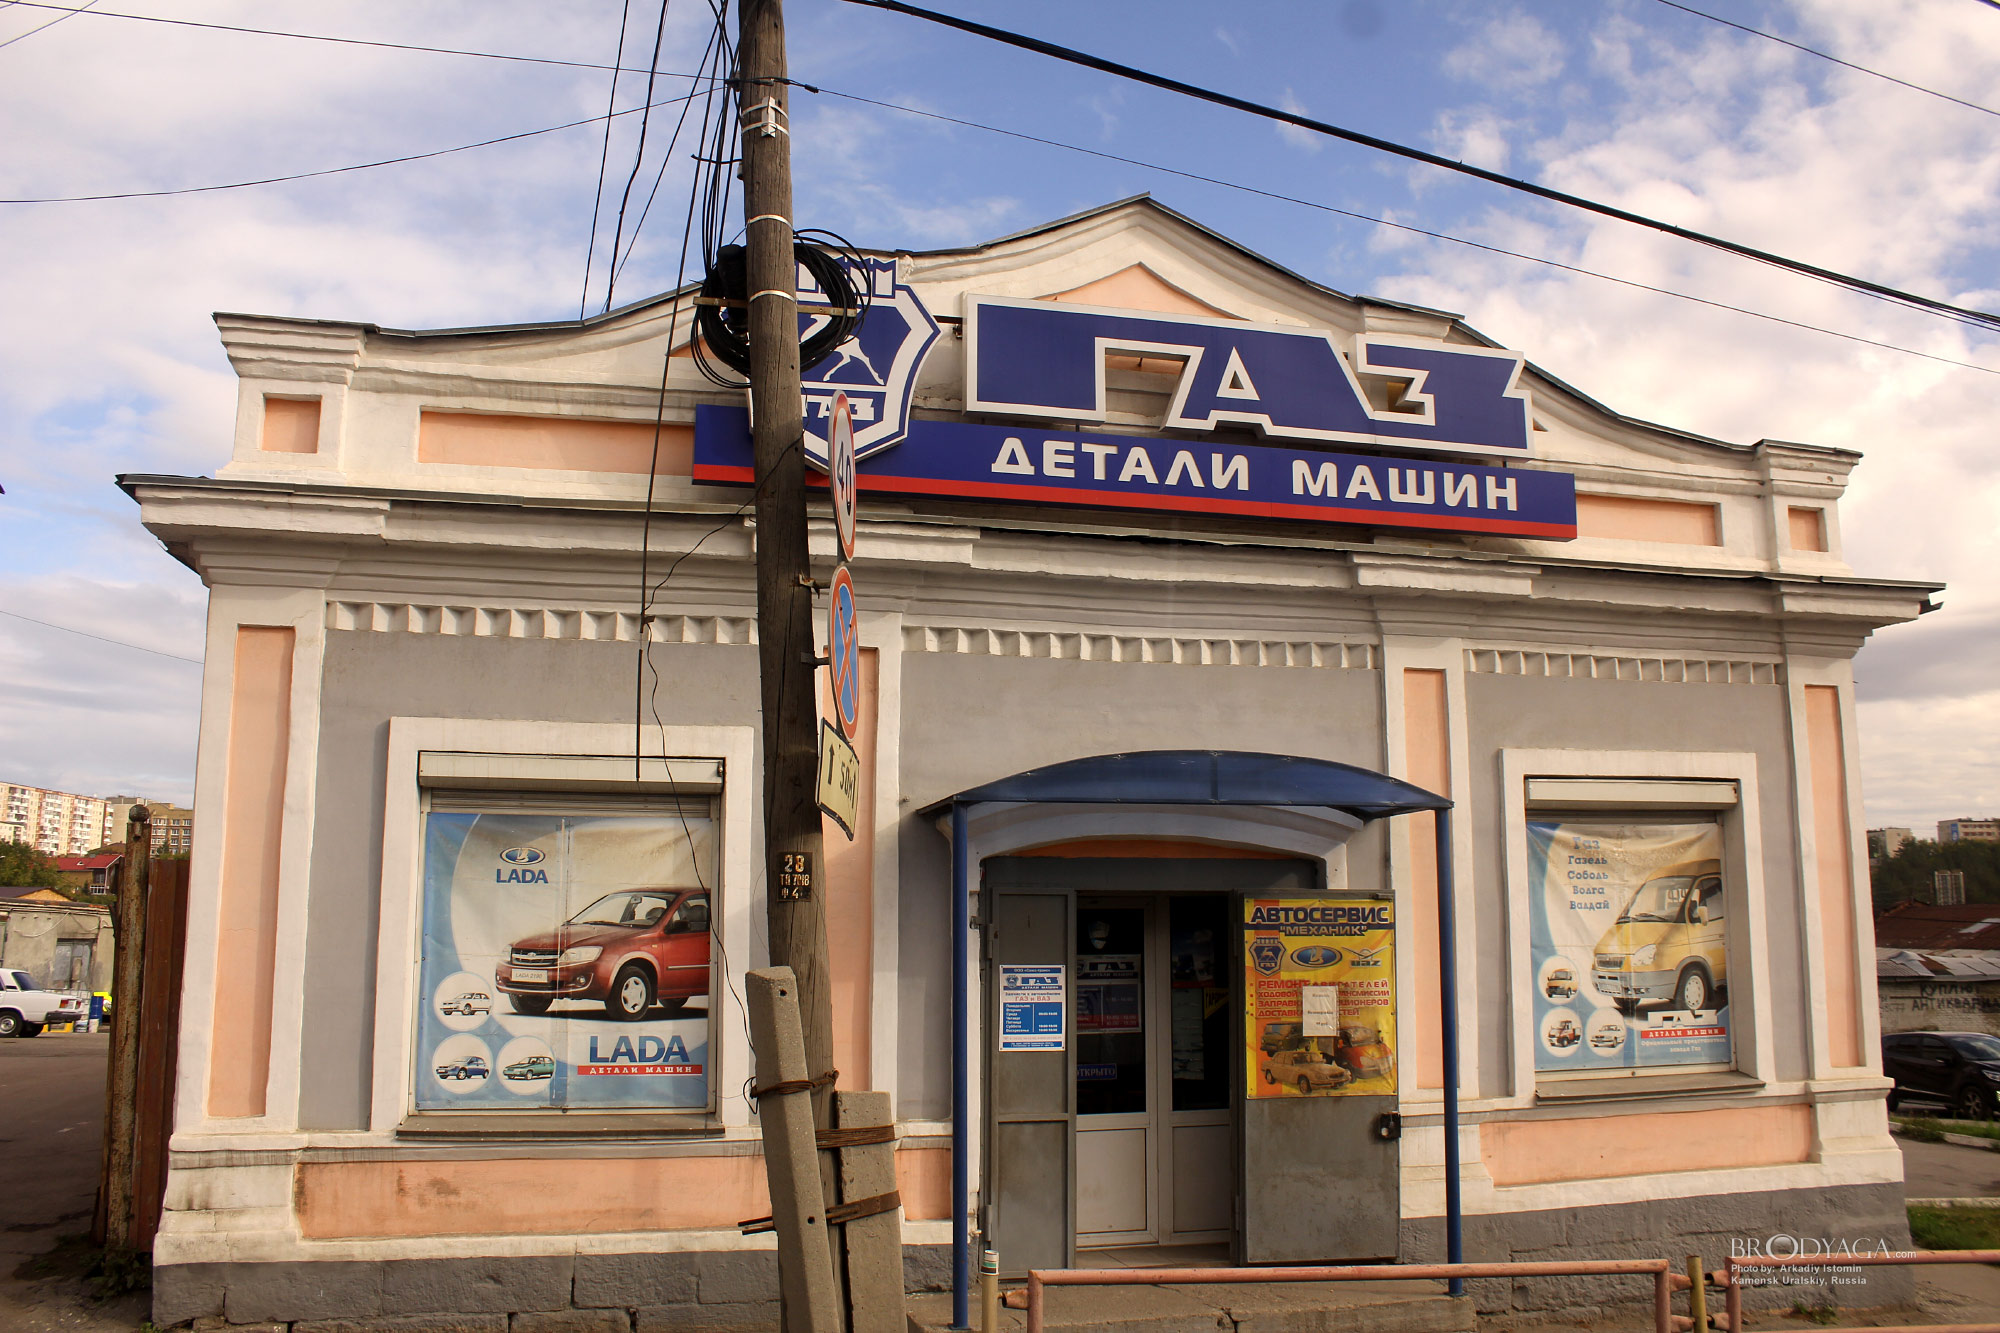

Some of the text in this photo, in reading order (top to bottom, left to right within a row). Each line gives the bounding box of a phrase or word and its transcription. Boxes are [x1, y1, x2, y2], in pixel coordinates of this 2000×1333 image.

[967, 294, 1534, 459] ГАЗ
[836, 441, 852, 516] 40
[991, 437, 1518, 511] ДЕТАЛИ МАШИН
[784, 854, 805, 873] 28
[1568, 855, 1608, 865] Газель
[496, 868, 549, 884] LADA
[1567, 870, 1609, 880] Соболь
[1569, 900, 1610, 911] Валдай
[1249, 906, 1390, 924] АВТОСЕРВИС
[1089, 962, 1135, 971] ГАЗ
[1021, 976, 1058, 985] ГАЗ
[1258, 980, 1310, 989] РЕМОНТ
[1258, 990, 1298, 998] ХОДОВОЙ
[1648, 1010, 1718, 1028] ГАЗ
[1687, 1028, 1719, 1036] МАШИН
[590, 1035, 691, 1063] LADA
